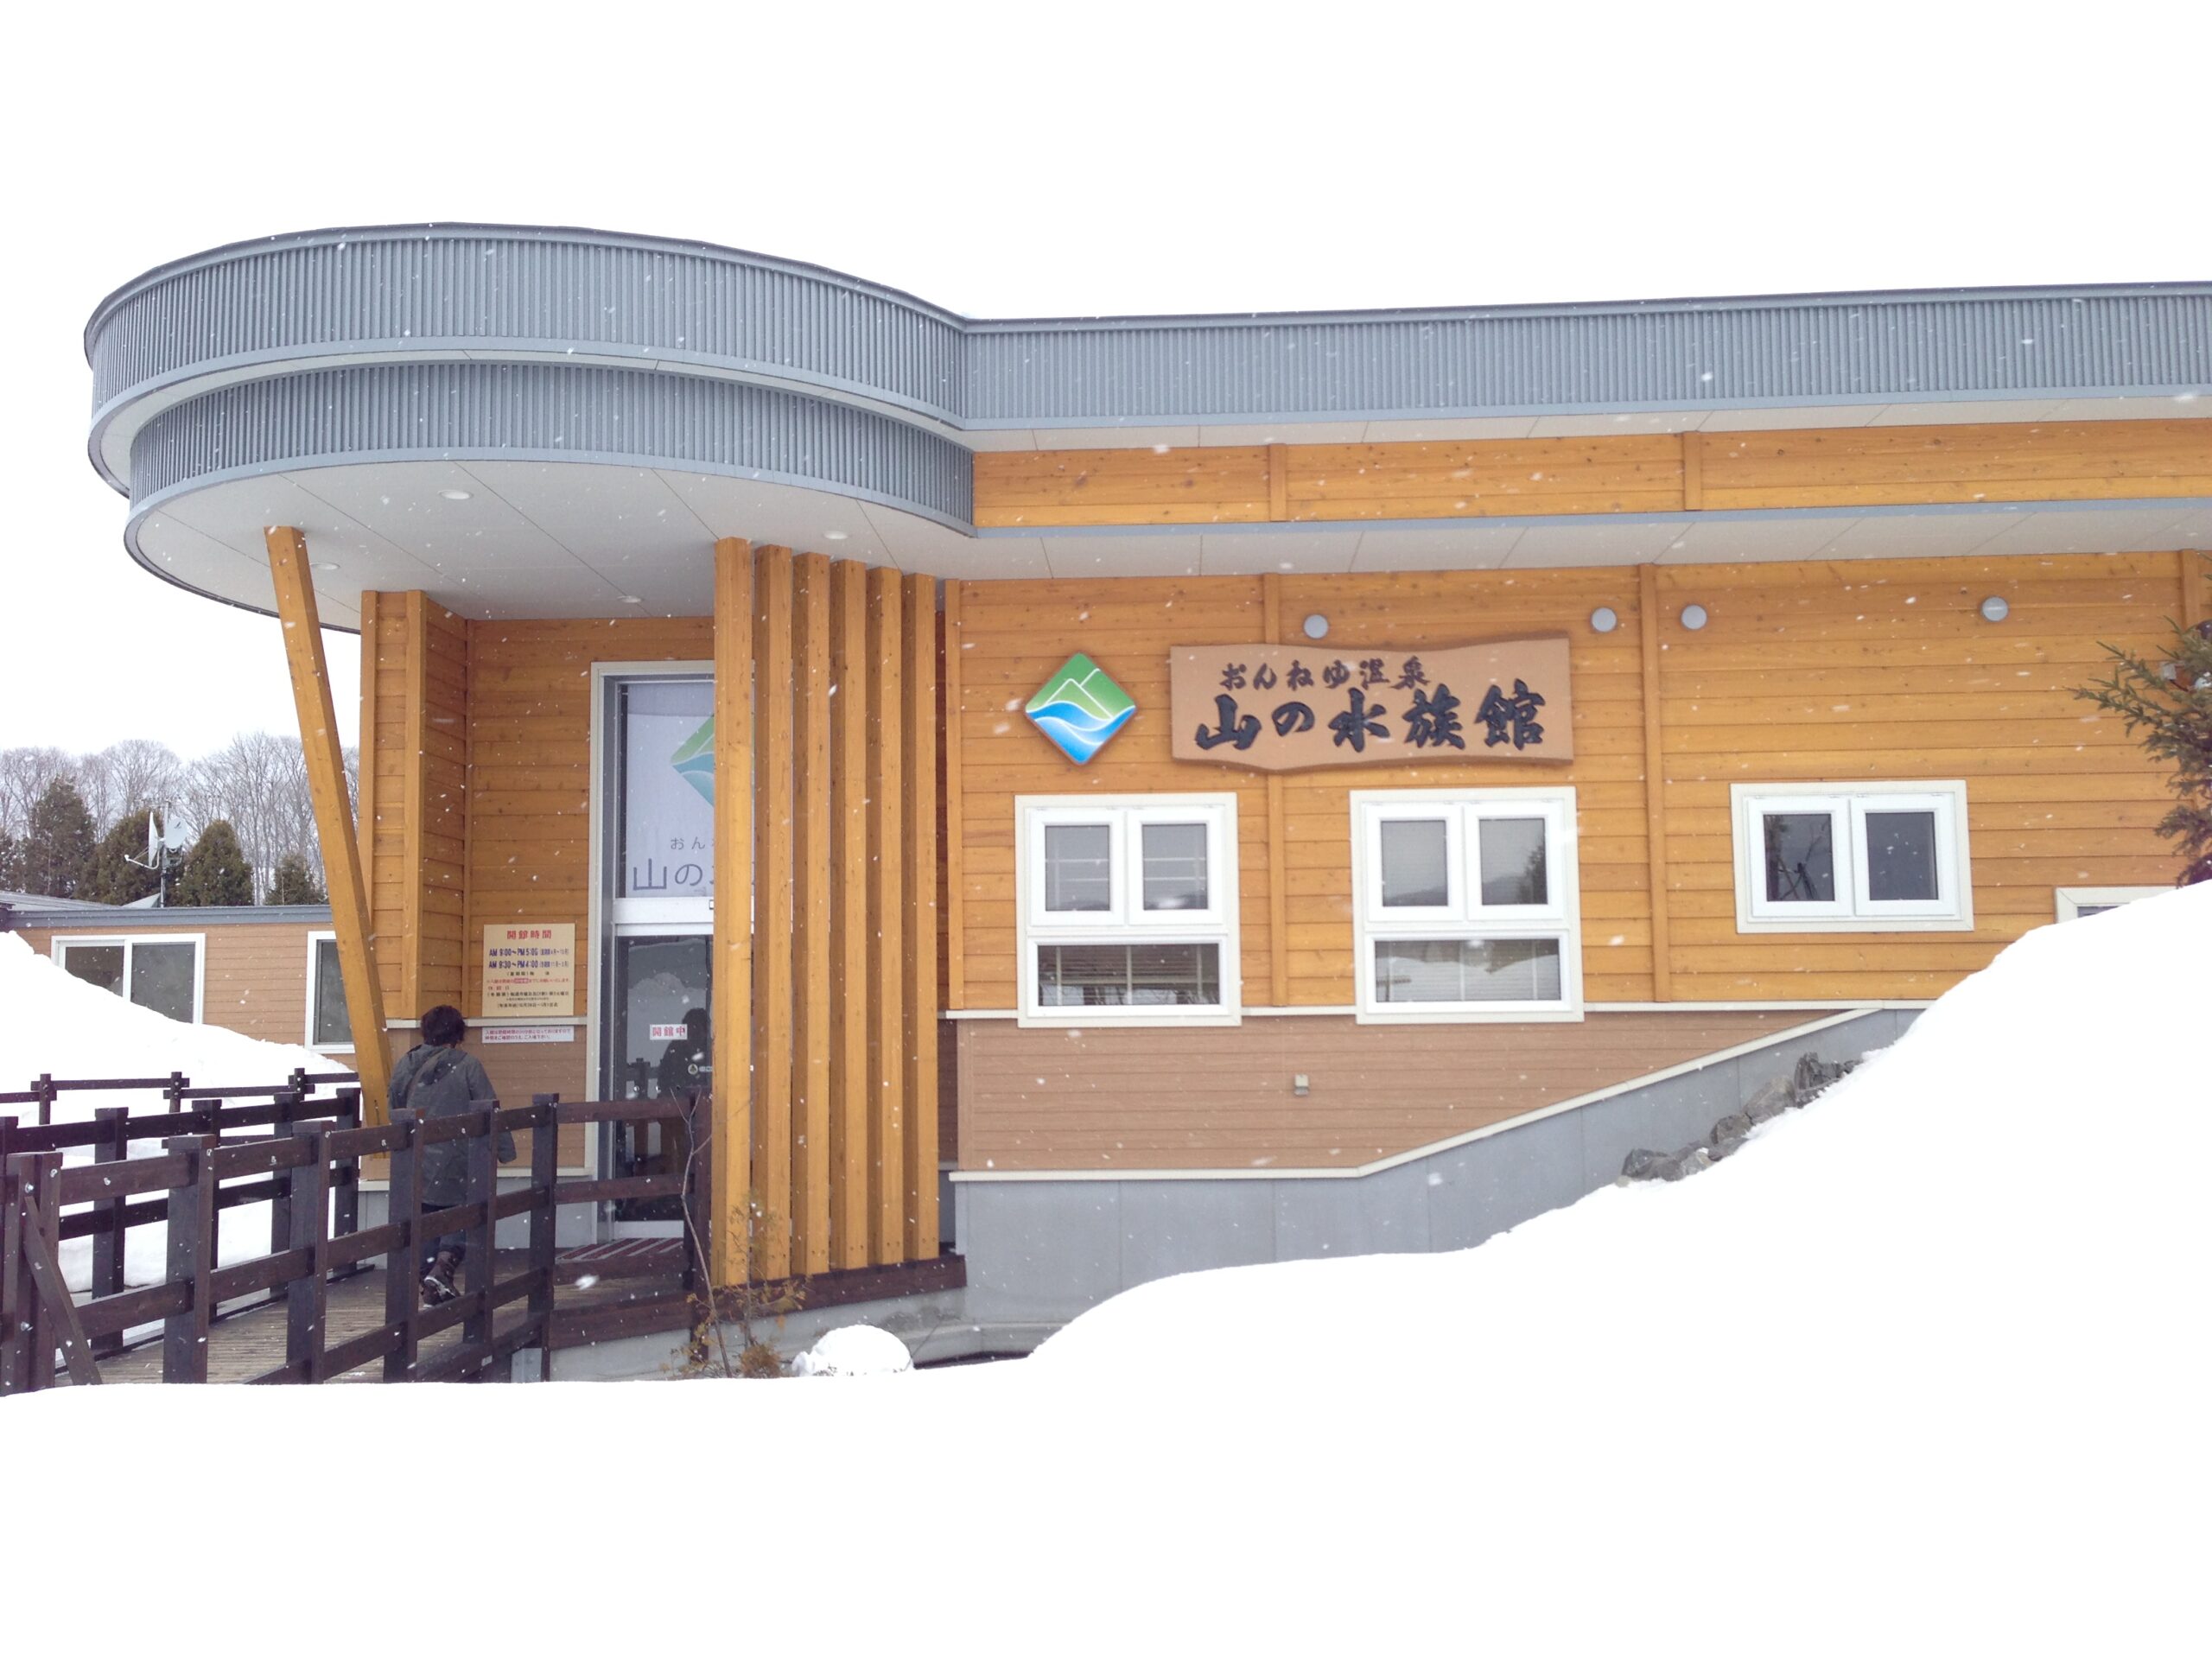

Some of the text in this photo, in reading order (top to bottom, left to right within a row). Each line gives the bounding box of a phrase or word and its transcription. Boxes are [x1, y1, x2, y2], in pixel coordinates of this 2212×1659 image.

[1220, 655, 1430, 690] おんねゆ温泉
[1194, 678, 1546, 752] 山の水族館
[670, 836, 714, 850] おん
[632, 858, 714, 890] 山の
